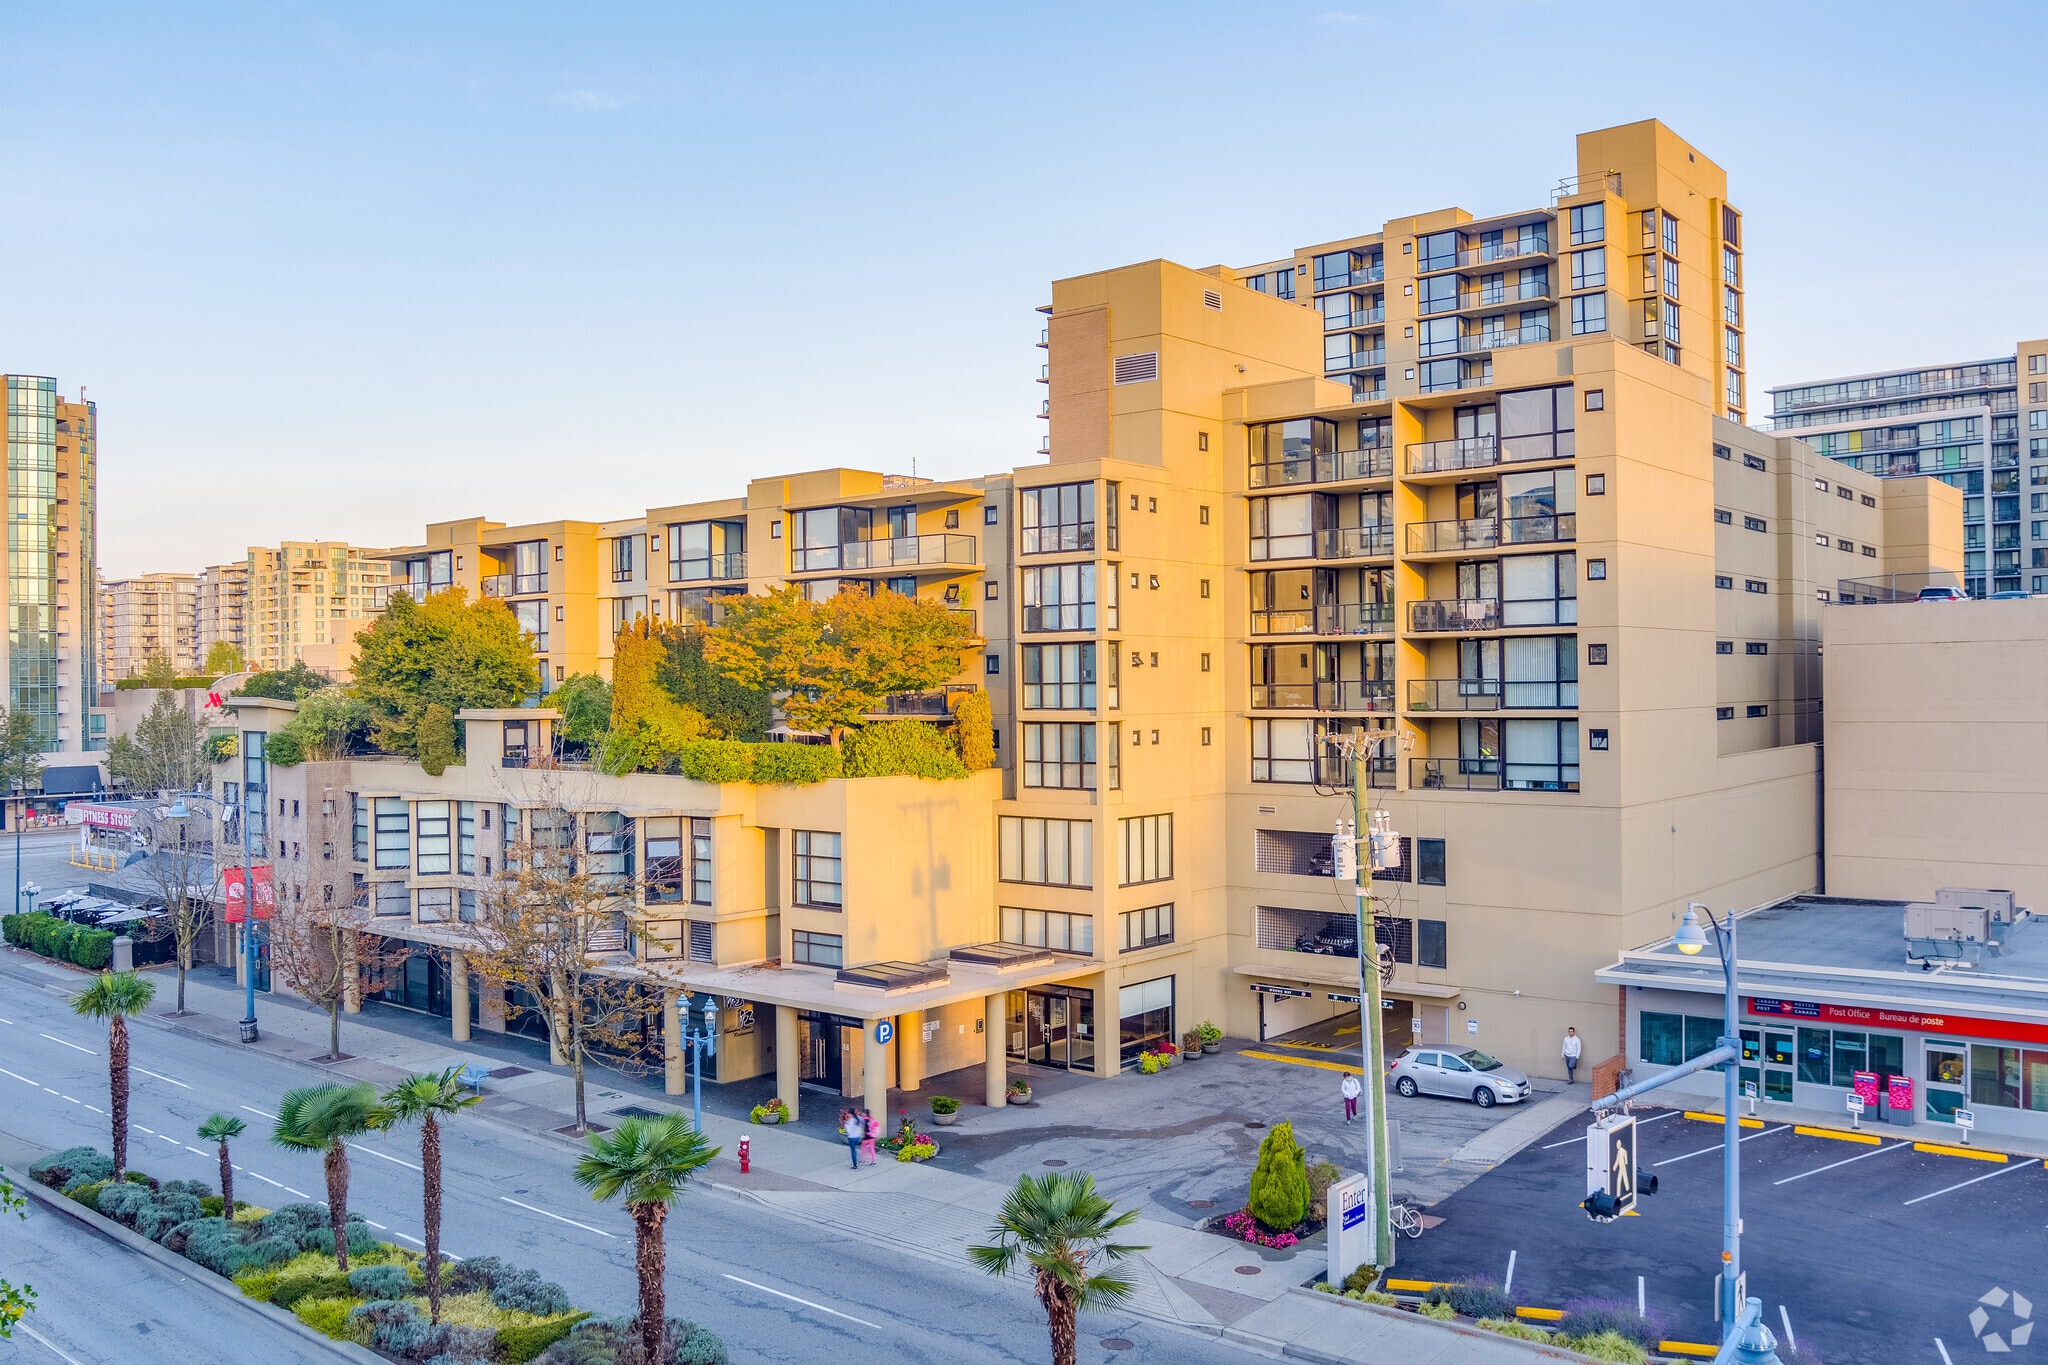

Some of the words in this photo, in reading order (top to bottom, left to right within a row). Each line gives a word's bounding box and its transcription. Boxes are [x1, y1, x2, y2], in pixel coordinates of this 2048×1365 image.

[83, 809, 108, 825] FITNESS
[1829, 1007, 1846, 1017] Post
[1847, 1008, 1871, 1019] Office
[1879, 1012, 1907, 1022] Bureau
[1909, 1015, 1920, 1024] de
[1921, 1017, 1944, 1026] poste
[880, 1024, 890, 1042] P
[1342, 1188, 1366, 1212] Enter
